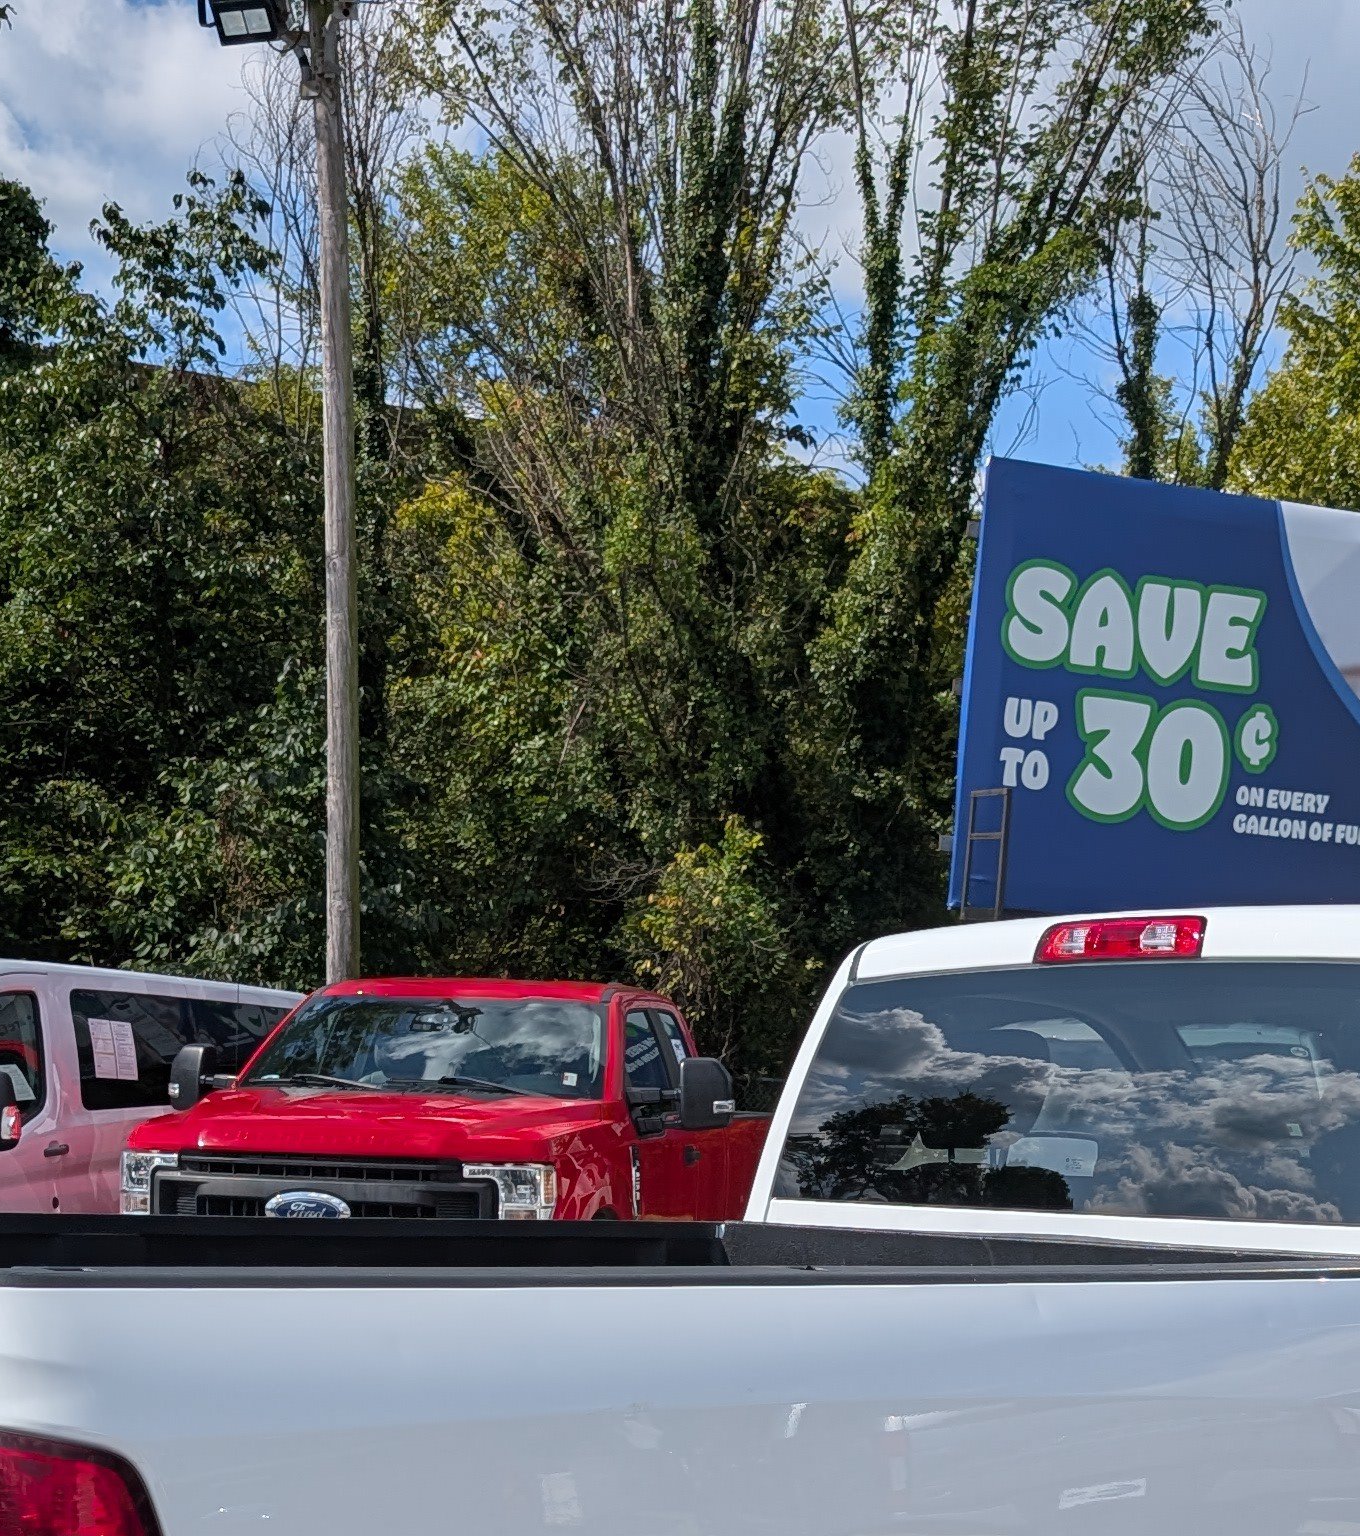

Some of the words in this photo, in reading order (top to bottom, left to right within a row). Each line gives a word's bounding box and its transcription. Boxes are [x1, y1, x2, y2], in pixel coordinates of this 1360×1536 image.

[1007, 565, 1262, 688] SAVE
[1003, 696, 1059, 741] UP
[999, 746, 1050, 791] TO
[1235, 785, 1265, 808] ON
[1266, 788, 1330, 815] EVERY
[1232, 813, 1307, 841] GALLON
[1308, 821, 1334, 843] OF
